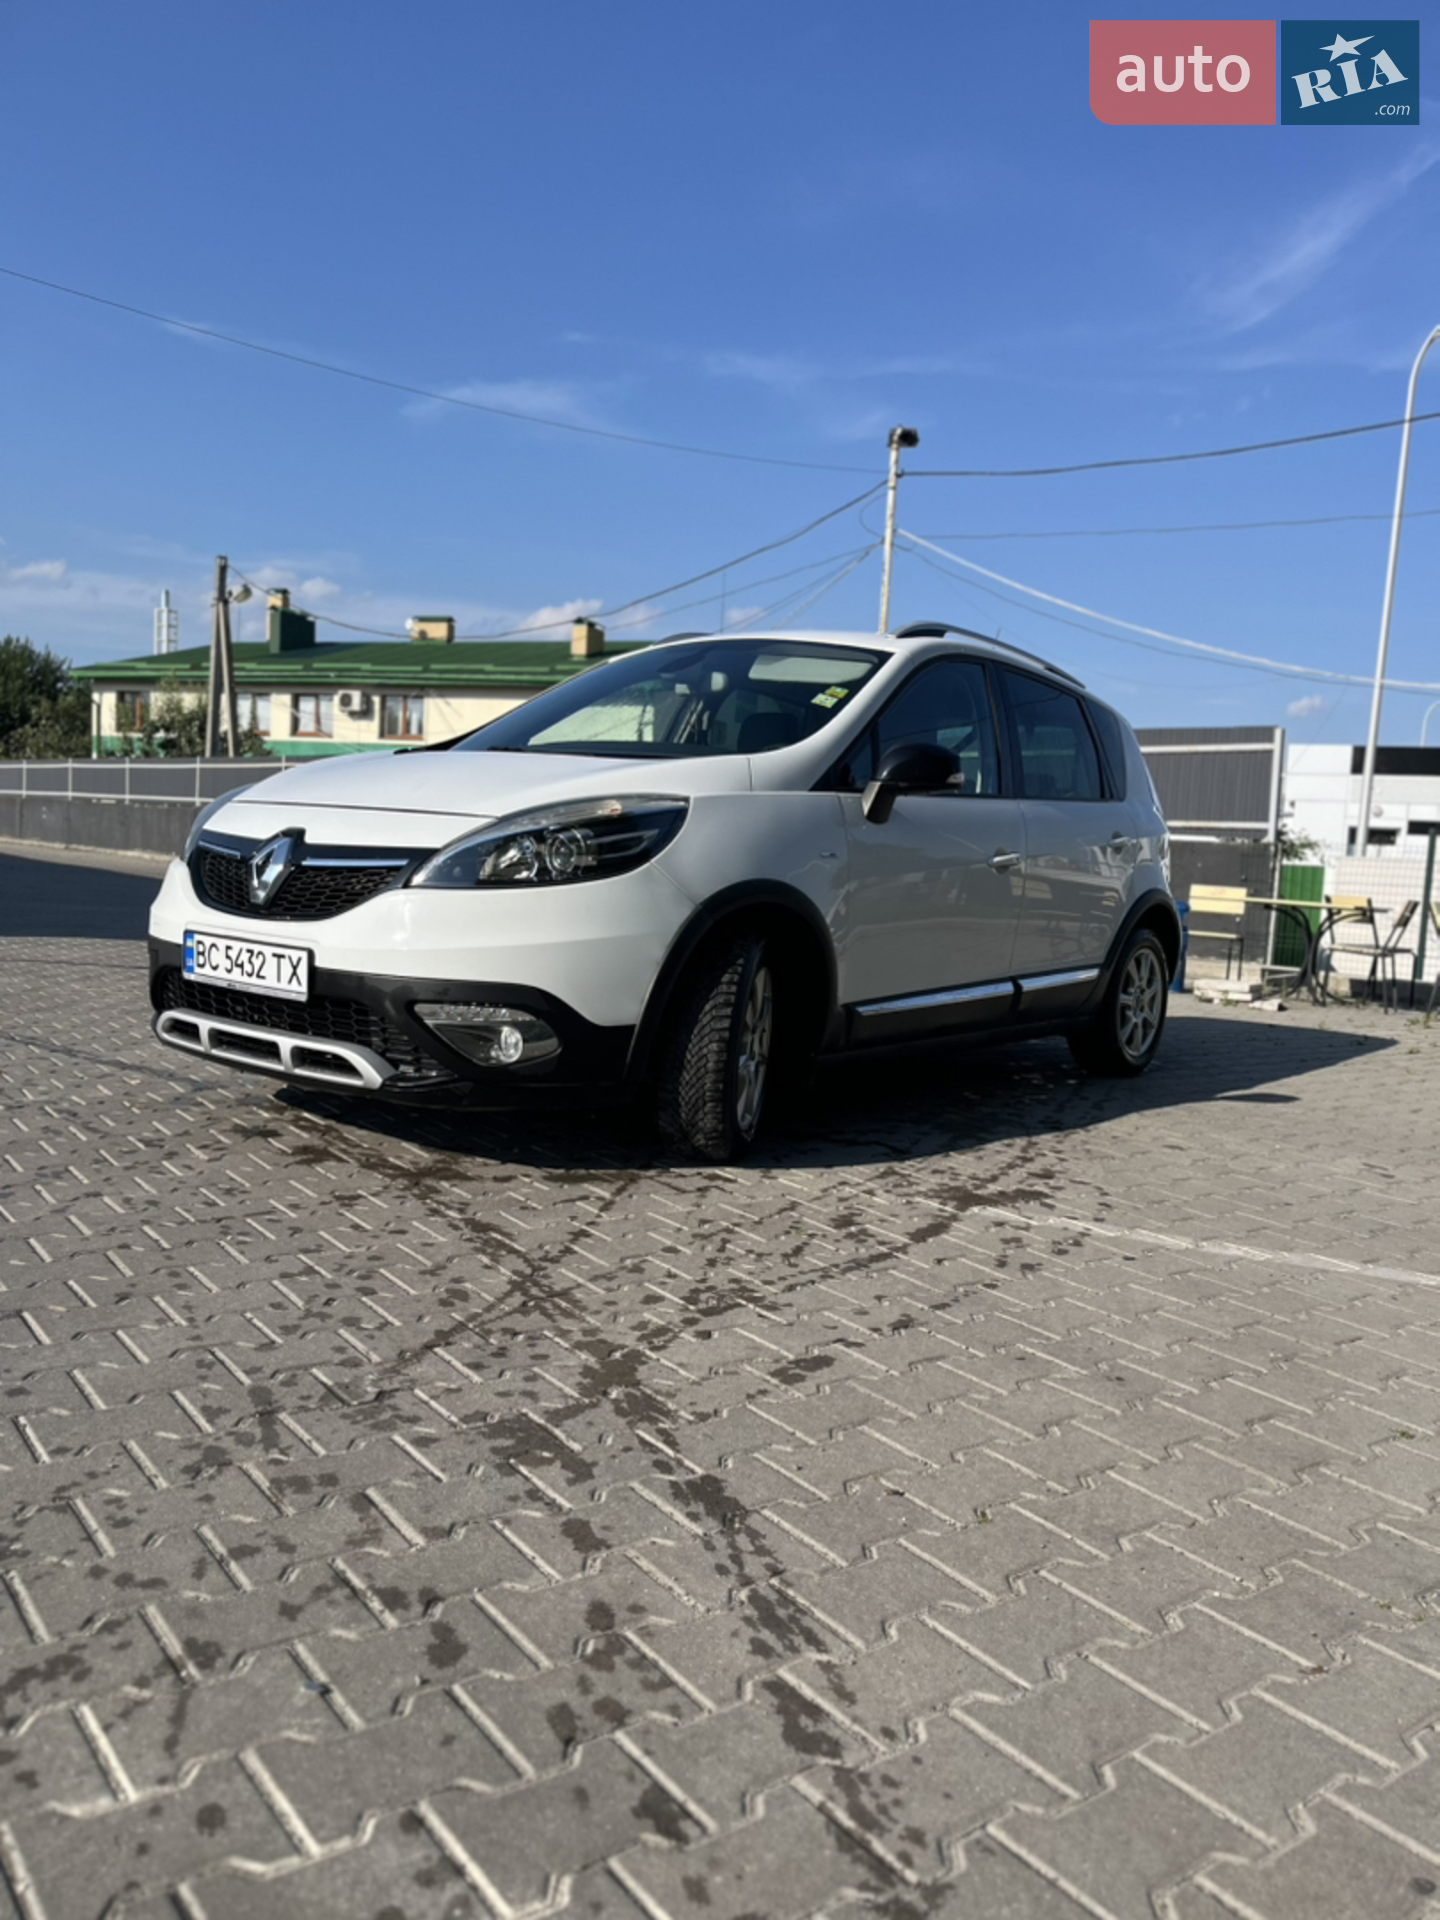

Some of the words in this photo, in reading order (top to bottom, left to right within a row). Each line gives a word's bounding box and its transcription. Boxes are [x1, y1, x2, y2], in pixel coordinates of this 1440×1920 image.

[196, 940, 220, 971] BC
[224, 944, 267, 980] 5432
[271, 952, 303, 987] TX
